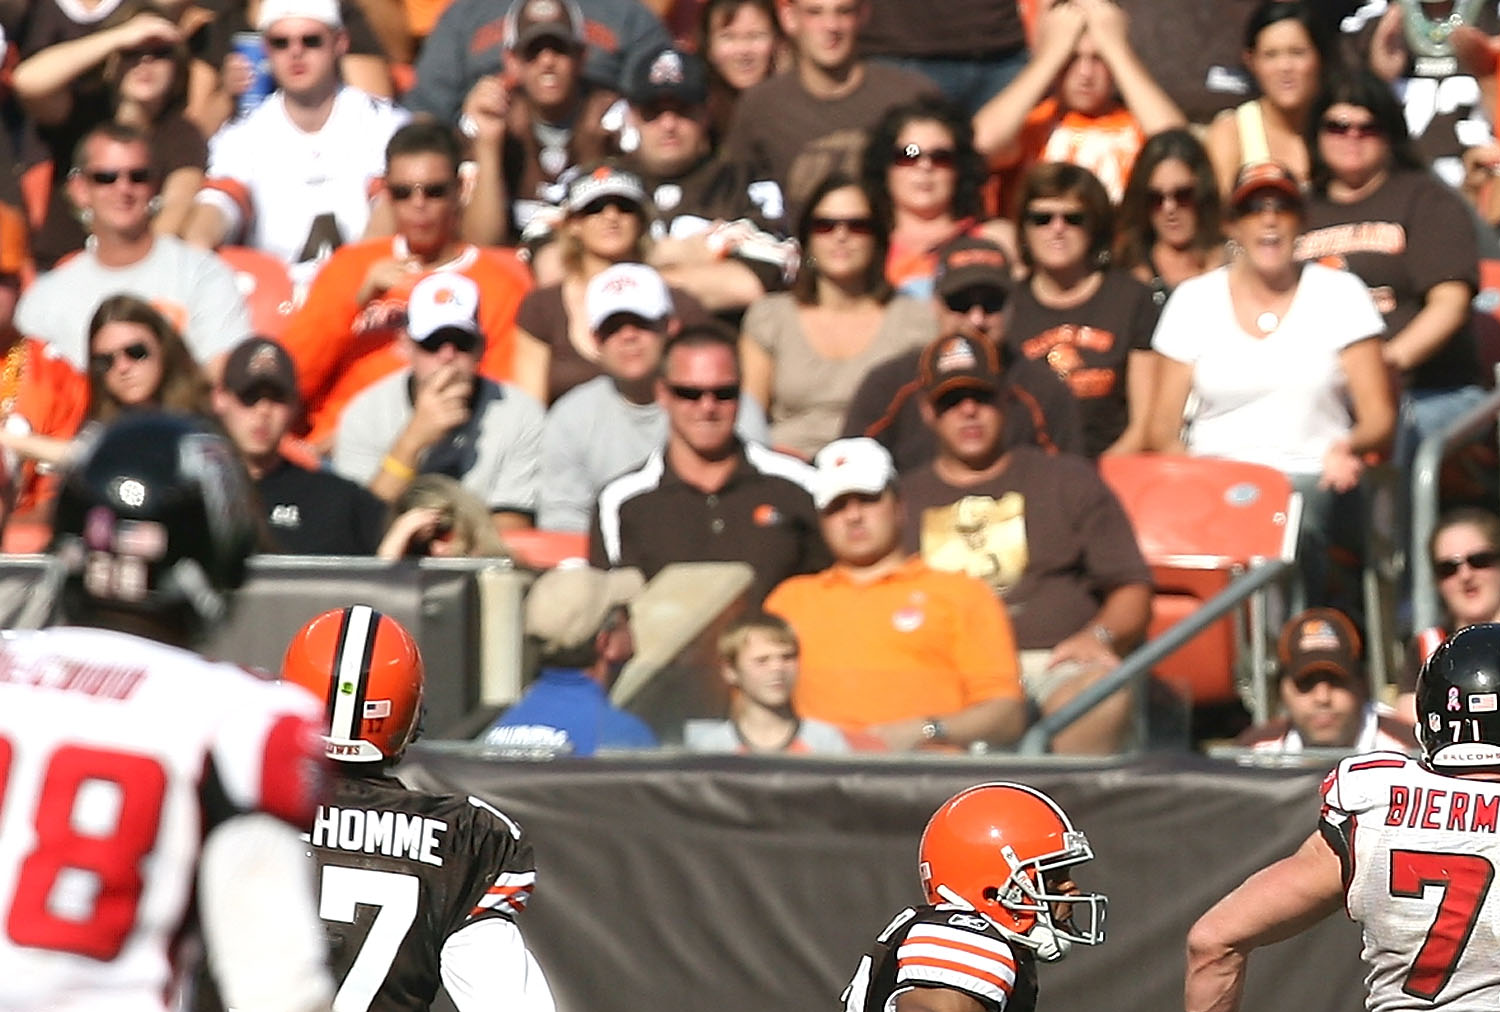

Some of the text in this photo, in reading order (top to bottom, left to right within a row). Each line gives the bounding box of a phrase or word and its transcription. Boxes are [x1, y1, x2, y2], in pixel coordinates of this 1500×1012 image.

[1449, 720, 1480, 742] 71
[0, 732, 167, 962] 8
[299, 805, 448, 867] HOMME
